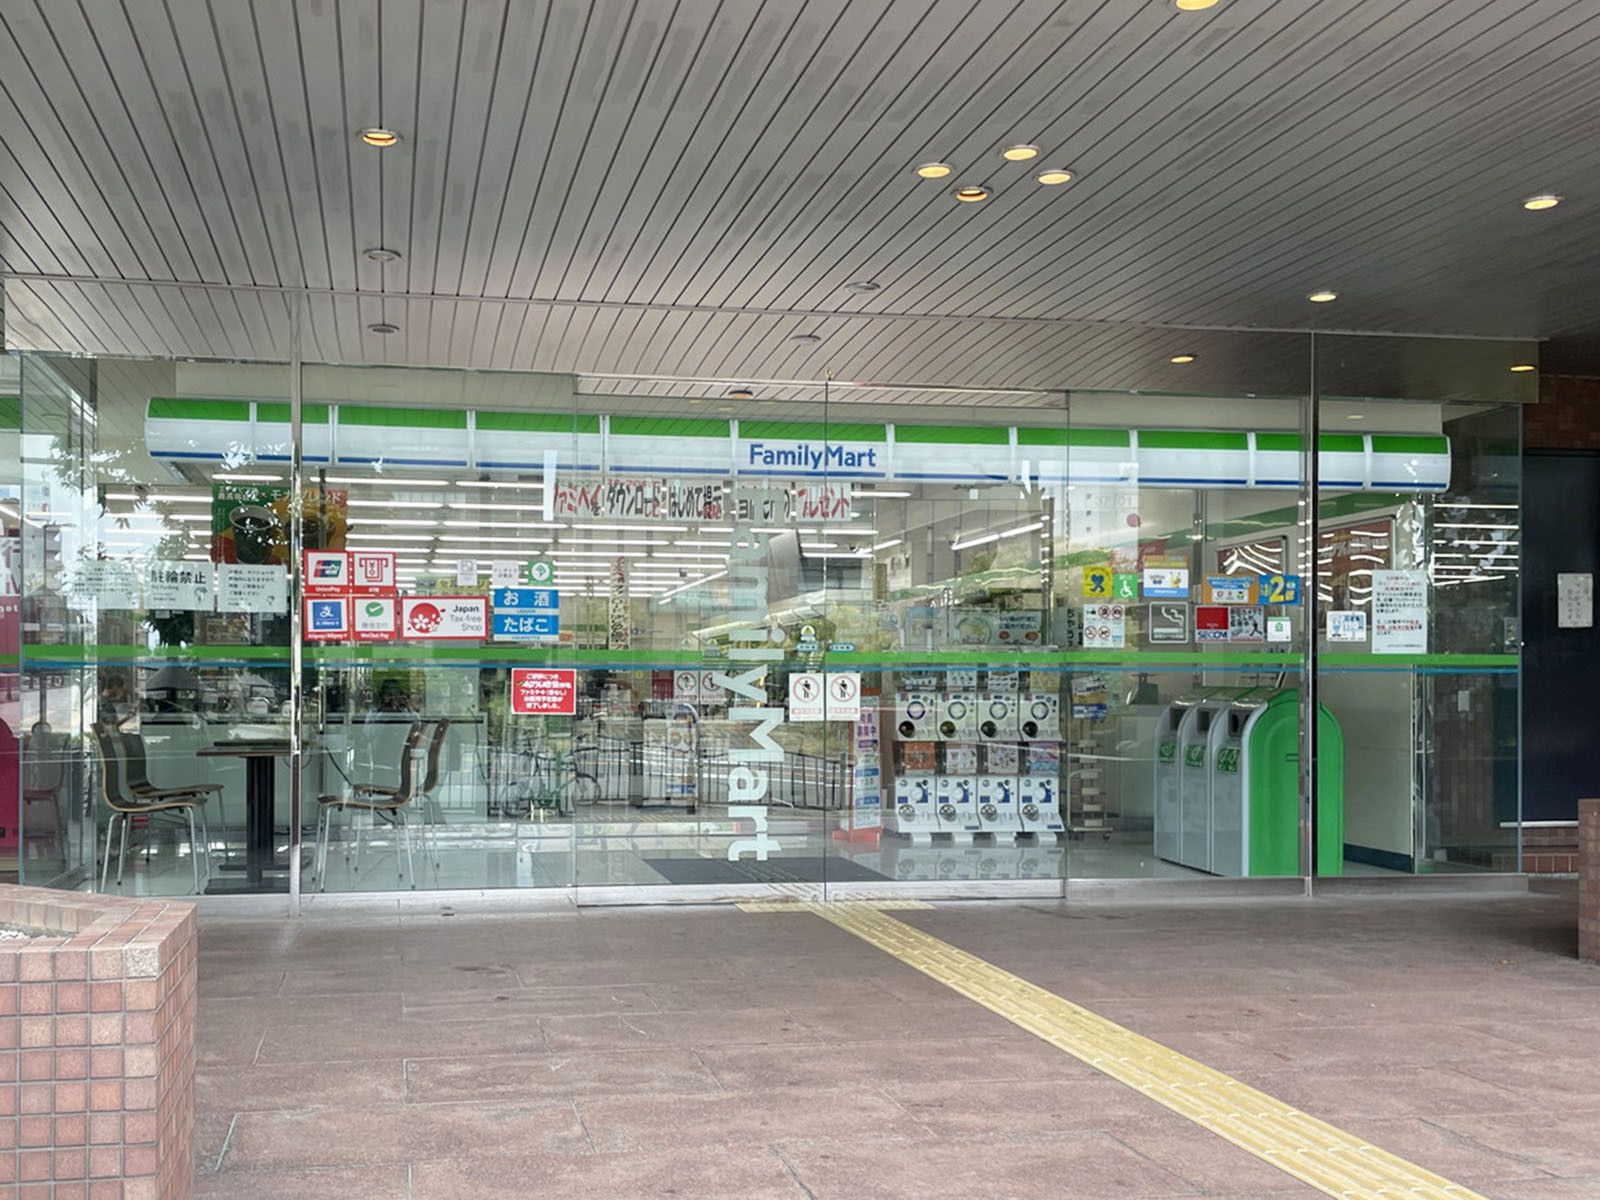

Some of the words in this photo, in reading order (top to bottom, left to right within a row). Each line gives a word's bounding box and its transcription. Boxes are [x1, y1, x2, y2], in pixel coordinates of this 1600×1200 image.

[749, 443, 876, 470] FamilyMart
[461, 623, 482, 632] Shop
[503, 616, 549, 633] たばこ
